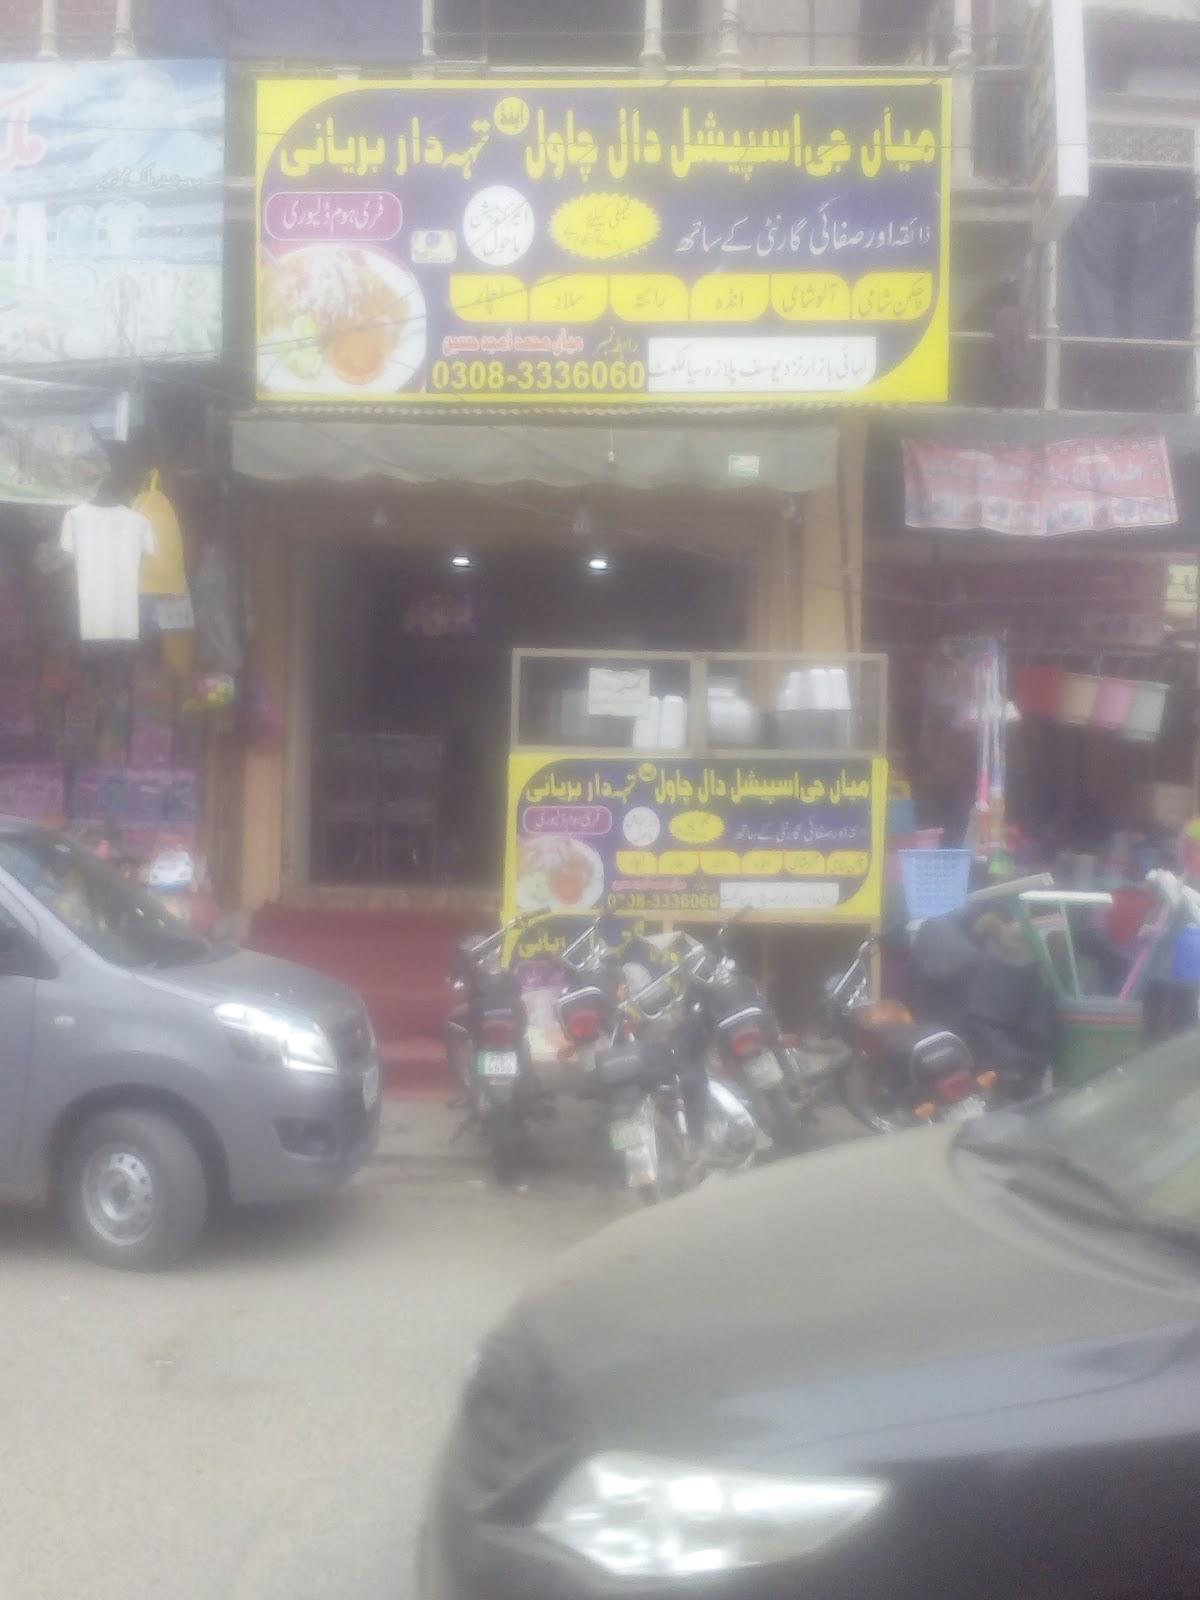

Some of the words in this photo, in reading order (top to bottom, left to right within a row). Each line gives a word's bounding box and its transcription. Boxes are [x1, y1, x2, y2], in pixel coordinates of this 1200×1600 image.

[280, 115, 387, 177] بریانی
[525, 108, 599, 182] چاول
[608, 107, 662, 179] دال
[804, 128, 851, 176] جی
[861, 106, 937, 178] میاں
[675, 216, 722, 254] ساتھ
[720, 216, 753, 252] کے
[864, 221, 894, 250] اور
[432, 361, 646, 390] 0308-3336060
